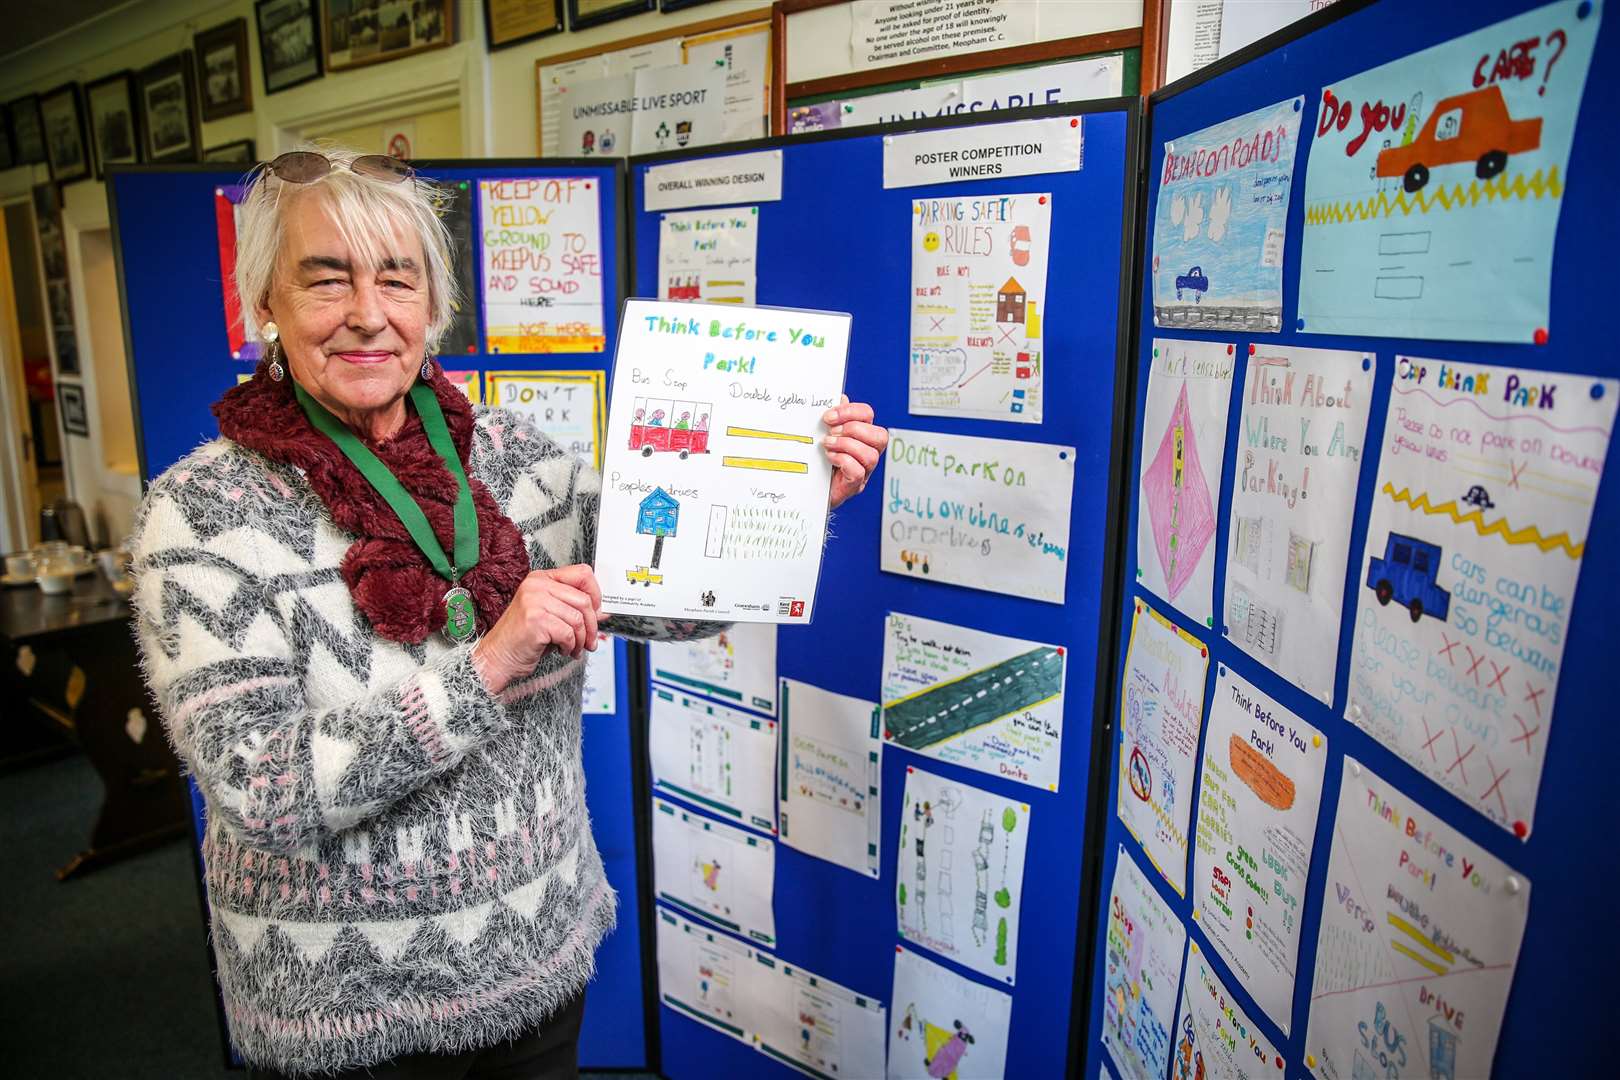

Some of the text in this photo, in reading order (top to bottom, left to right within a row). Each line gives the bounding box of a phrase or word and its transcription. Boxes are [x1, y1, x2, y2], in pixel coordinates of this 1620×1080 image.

[875, 15, 898, 25] Anyone
[899, 11, 923, 22] looking
[924, 7, 943, 17] under
[946, 4, 954, 12] 21
[956, 2, 975, 12] years
[880, 25, 891, 33] will
[902, 19, 922, 29] asked
[923, 16, 933, 25] for
[933, 13, 952, 24] proof
[962, 7, 993, 18] identity.
[874, 43, 882, 51] be
[883, 40, 905, 50] served
[906, 36, 930, 46] alcohol
[942, 31, 961, 40] these
[962, 26, 997, 38] premises.
[876, 34, 888, 42] one
[889, 31, 908, 40] under
[909, 28, 921, 36] the
[922, 27, 934, 36] age
[936, 23, 944, 31] of
[945, 22, 954, 30] 18
[956, 20, 969, 28] will
[970, 13, 1008, 27] knowingly
[867, 51, 898, 62] Chairman
[899, 48, 911, 57] and
[953, 36, 988, 49] Meopham
[573, 97, 638, 120] UNMISSABLE
[642, 94, 667, 111] LIVE
[669, 89, 707, 107] SPORT
[1318, 94, 1352, 138] Do
[914, 143, 1043, 166] POSTER COMPETITION
[658, 172, 765, 192] OVERALL WINNING DESIGN
[949, 163, 1003, 178] WINNERS
[489, 179, 582, 204] KEEP OFF
[490, 205, 555, 228] YELLOW
[919, 200, 965, 226] PARKING
[484, 229, 587, 253] GROUND TO
[944, 225, 993, 256] RULES
[560, 254, 601, 276] SAFE
[489, 275, 580, 294] AND SOUND
[519, 297, 556, 308] HERE
[644, 315, 826, 348] Think Before You
[702, 352, 757, 375] Park!
[1231, 685, 1307, 754] Think Before You
[1250, 729, 1275, 760] Park!
[1367, 787, 1401, 829] Think
[1405, 816, 1455, 868] Before
[1399, 849, 1436, 891] Park!
[1200, 966, 1218, 1000] Think
[1219, 996, 1248, 1040] Before
